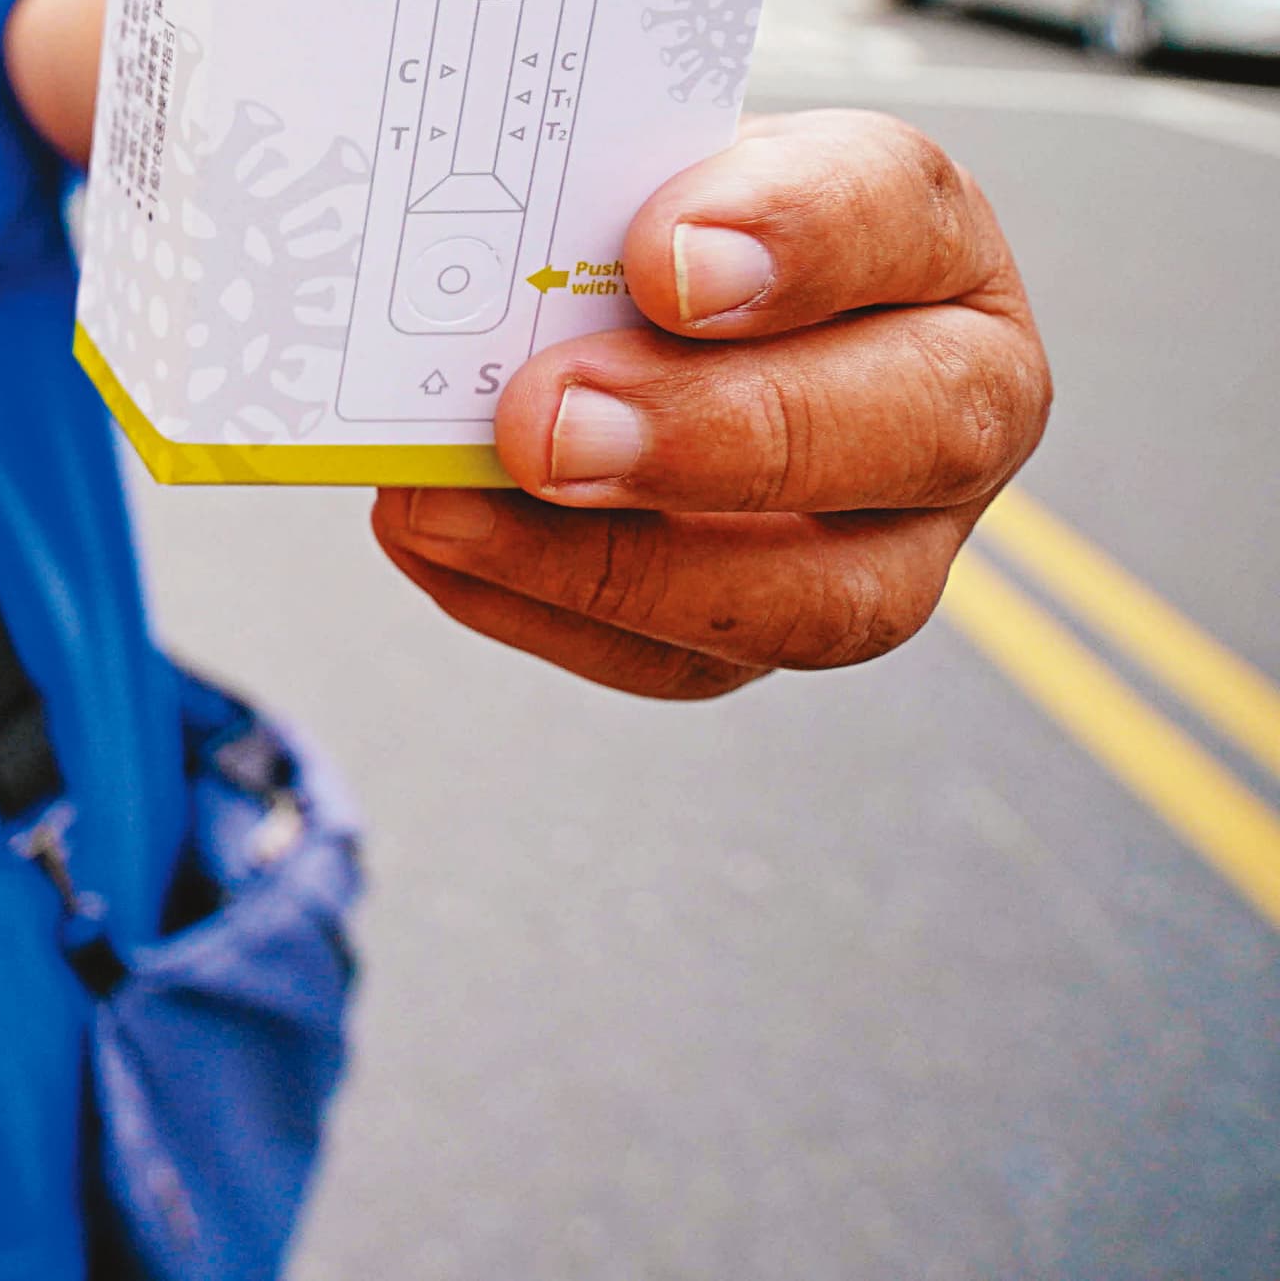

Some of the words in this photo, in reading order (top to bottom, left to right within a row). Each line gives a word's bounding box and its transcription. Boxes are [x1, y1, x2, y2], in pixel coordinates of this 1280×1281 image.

[398, 59, 420, 84] C
[560, 51, 578, 73] C
[390, 126, 410, 151] T
[575, 260, 624, 276] Push
[572, 279, 618, 295] with
[474, 363, 503, 395] S
